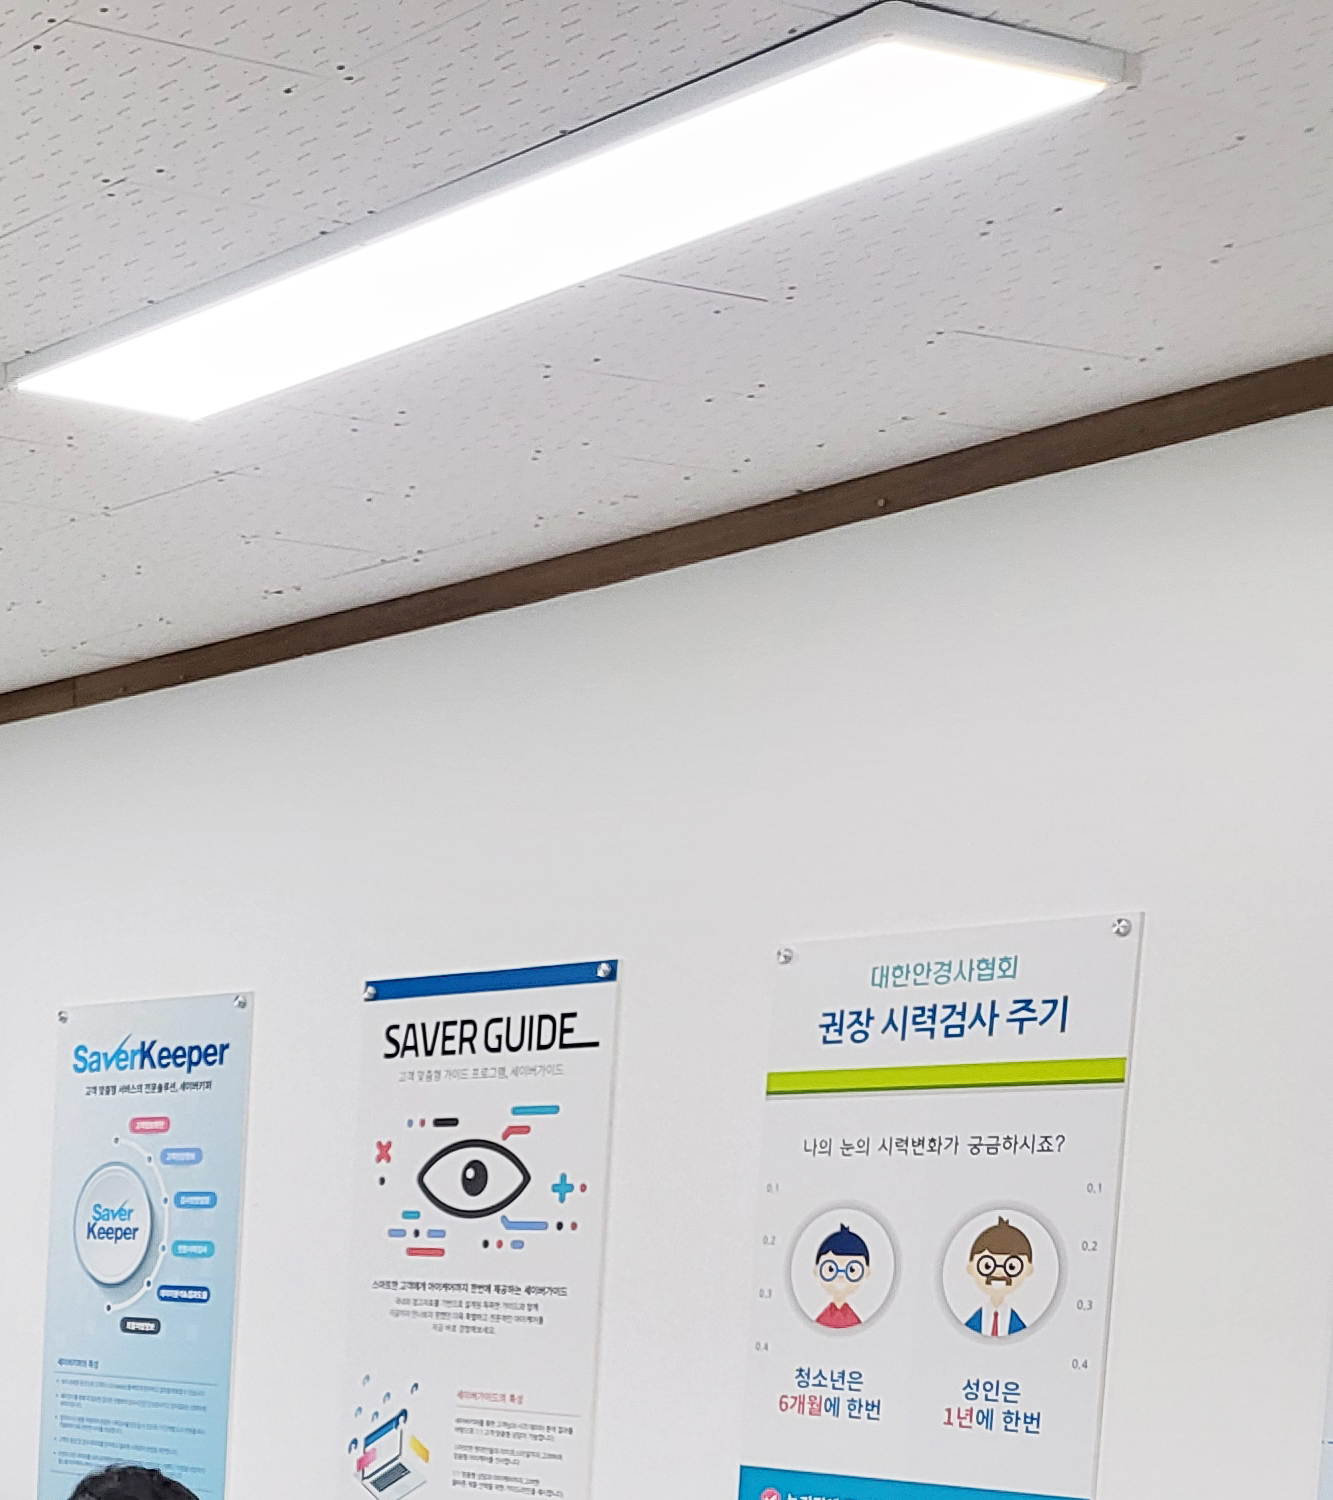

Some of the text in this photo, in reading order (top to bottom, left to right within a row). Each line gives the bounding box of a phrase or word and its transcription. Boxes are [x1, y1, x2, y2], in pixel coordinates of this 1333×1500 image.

[871, 955, 1018, 989] 대한안경사협회
[818, 995, 1069, 1045] 권장 시력검사 주기
[383, 1012, 599, 1059] SAVER GUIDE
[72, 1033, 230, 1074] SaverKeeper
[804, 1134, 1066, 1157] 나의 눈의 시력변화가 궁금하시죠?
[1086, 1183, 1102, 1194] 0.1
[92, 1199, 134, 1222] Saver
[86, 1222, 139, 1244] Keeper
[1081, 1241, 1098, 1252] 0.2
[1076, 1300, 1093, 1311] 0.3
[1071, 1358, 1088, 1370] 0.4
[794, 1367, 864, 1392] 청소년은
[961, 1378, 1021, 1404] 성인은
[779, 1394, 881, 1421] 6개월에 한번
[943, 1406, 1041, 1435] 1년에 한번
